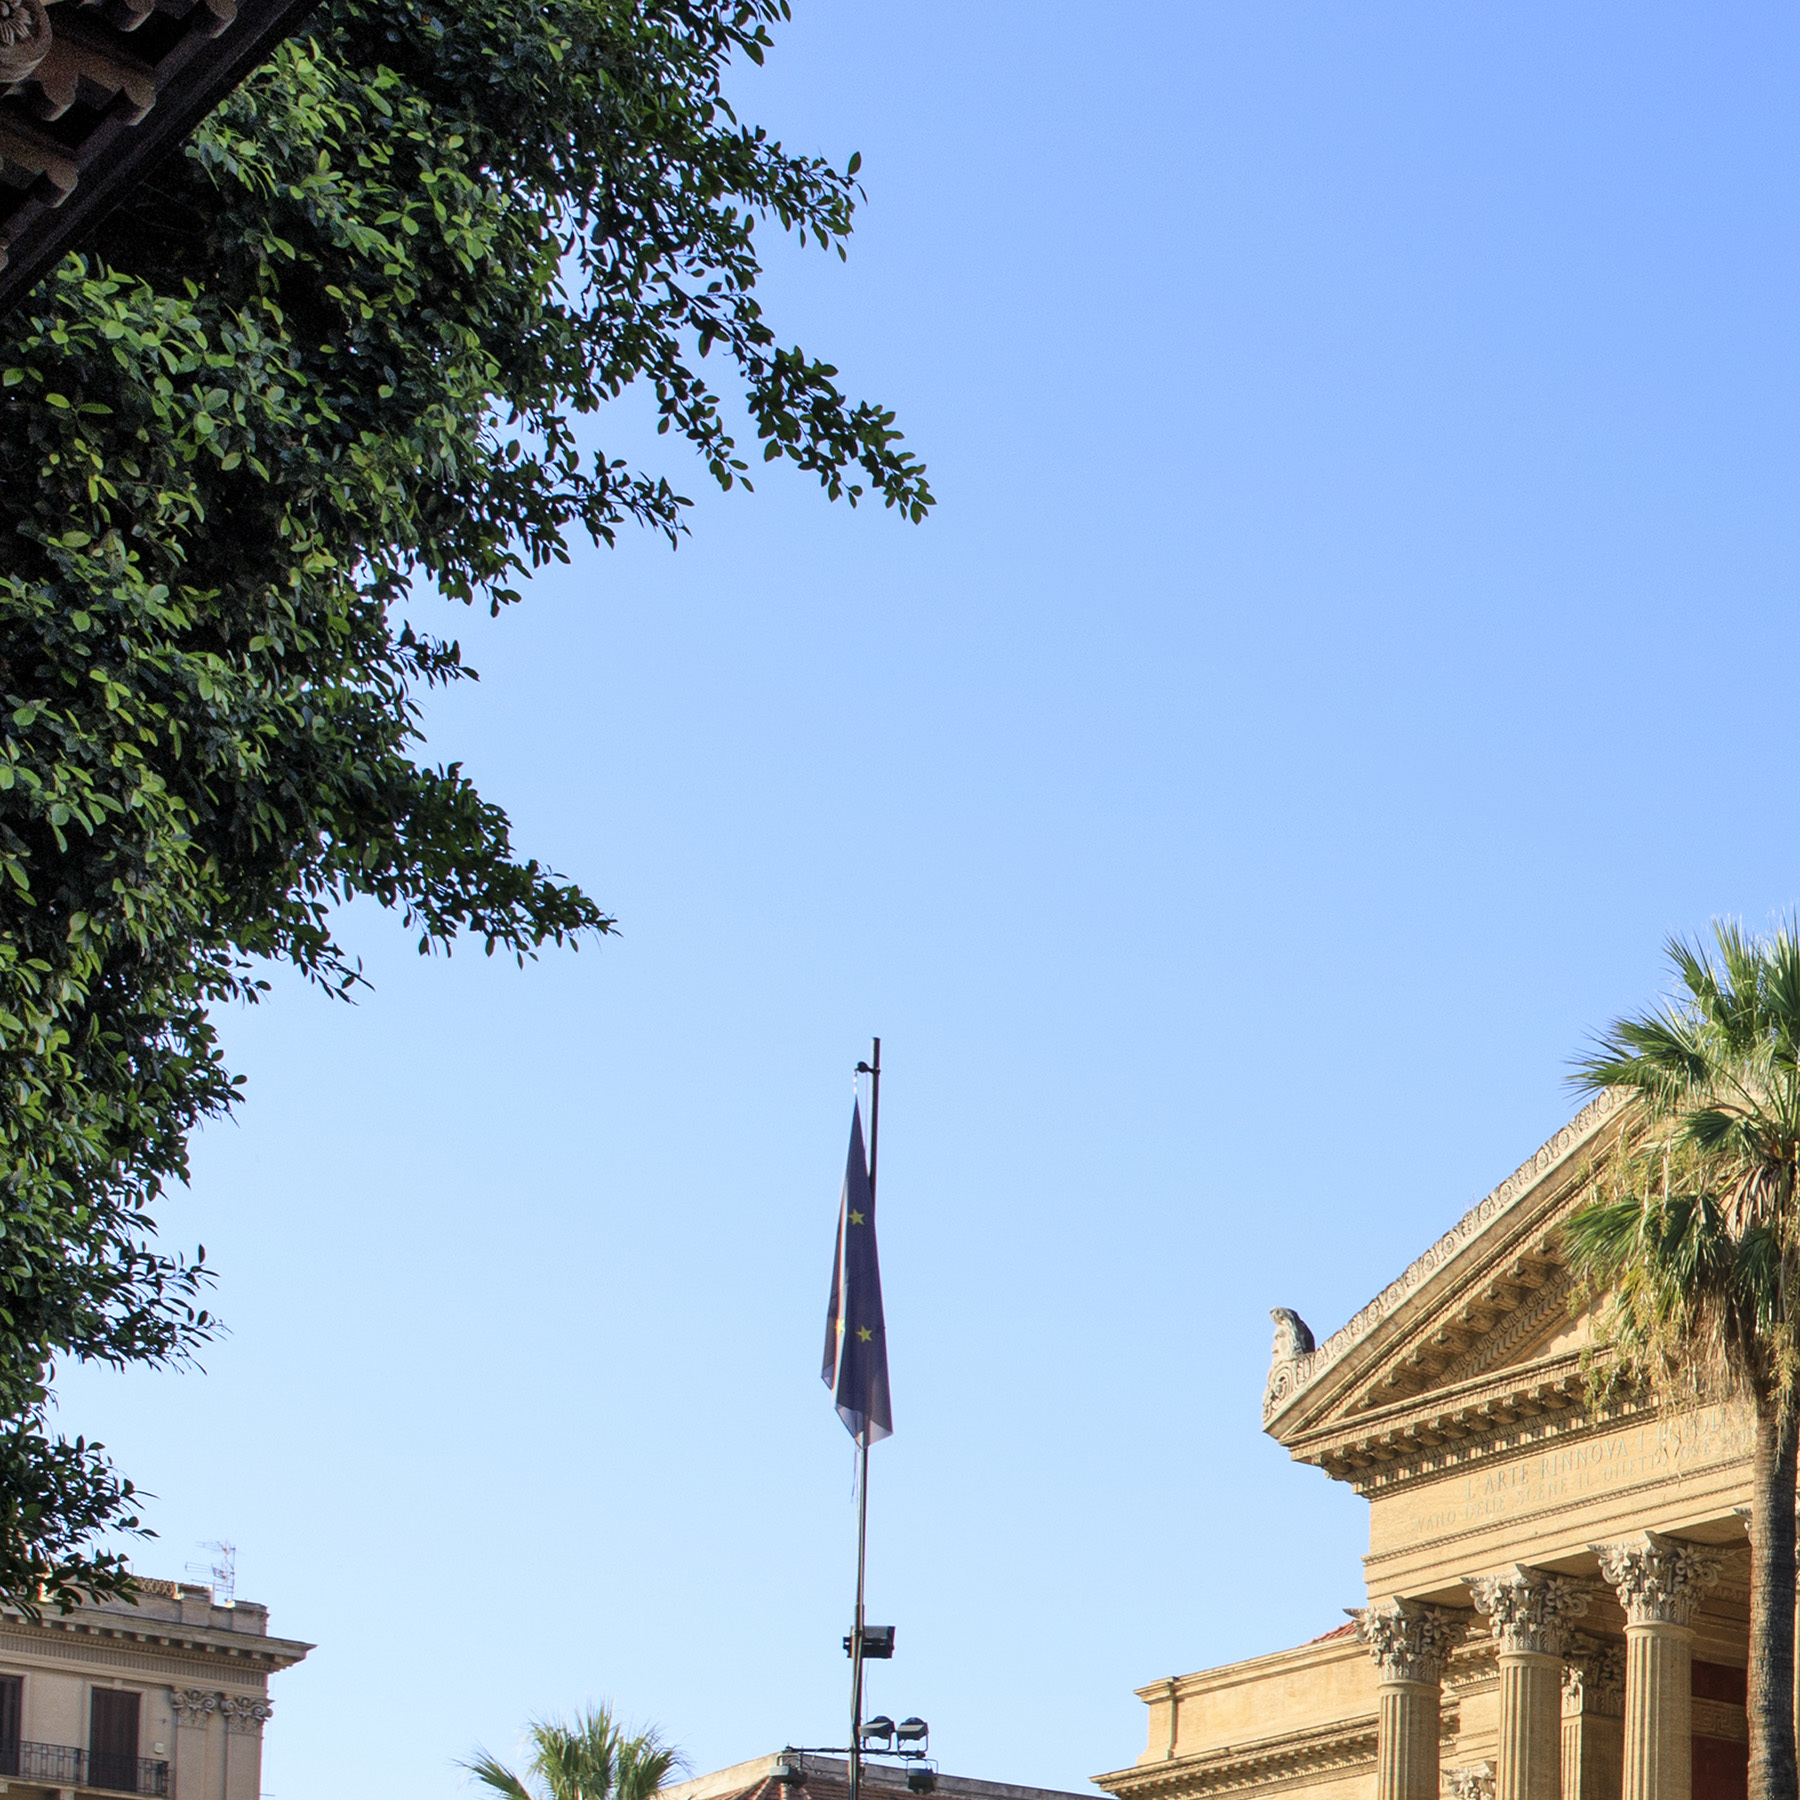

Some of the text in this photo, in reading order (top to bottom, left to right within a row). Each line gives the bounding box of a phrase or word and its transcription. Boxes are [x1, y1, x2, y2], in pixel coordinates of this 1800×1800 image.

[1416, 1509, 1456, 1532] VANO
[1464, 1494, 1505, 1520] DELLE
[1517, 1477, 1568, 1506] SCENE
[1577, 1471, 1592, 1489] IL
[1603, 1453, 1668, 1483] DILETTO
[1466, 1463, 1529, 1500] L'ARTE
[1540, 1436, 1628, 1479] RINNOVA
